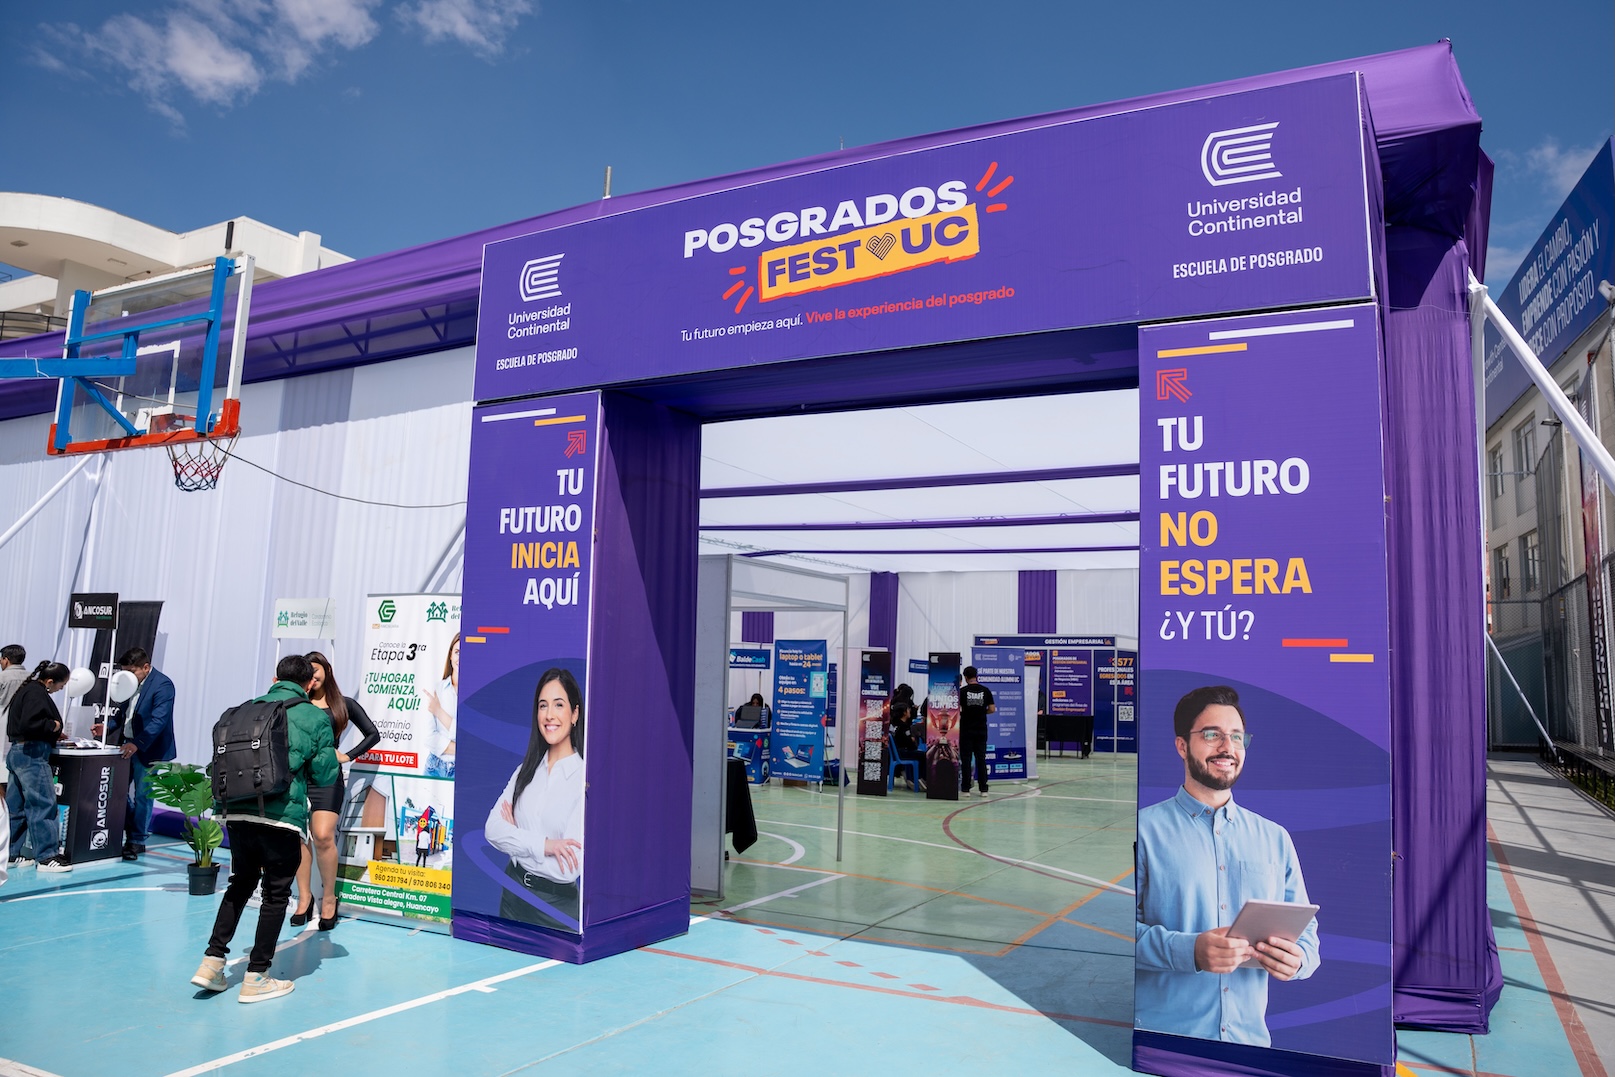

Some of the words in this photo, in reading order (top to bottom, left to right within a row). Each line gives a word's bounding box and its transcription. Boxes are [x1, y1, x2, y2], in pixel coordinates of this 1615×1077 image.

[1187, 187, 1302, 217] Universidad
[684, 180, 968, 258] POSGRADOS
[1188, 207, 1303, 237] Continental
[767, 239, 861, 288] FEST
[901, 216, 970, 255] UC
[1173, 258, 1228, 279] ESCUELA
[1230, 256, 1246, 272] DE
[1249, 246, 1323, 270] POSGRADO
[1538, 252, 1546, 280] EL
[1544, 217, 1573, 271] CAMBIO,
[1521, 278, 1554, 337] EMPRENDE
[1552, 260, 1568, 299] CON
[1566, 226, 1594, 282] PASIÓN
[1592, 218, 1600, 249] Y
[508, 302, 572, 325] Universidad
[681, 329, 693, 342] Tu
[694, 324, 726, 340] futuro
[728, 318, 774, 337] empieza
[776, 313, 804, 331] aquí.
[806, 309, 833, 325] Vive
[834, 308, 846, 321] la
[848, 297, 924, 320] experiencia
[926, 294, 947, 308] del
[949, 286, 1016, 308] posgrado
[1543, 311, 1558, 348] CON
[1556, 270, 1595, 334] PROPÓSITO
[508, 318, 570, 339] Continental
[496, 355, 526, 371] ESCUELA
[528, 353, 537, 366] DE
[538, 347, 578, 365] POSGRADO
[1157, 415, 1204, 452] TU
[556, 468, 584, 496] TU
[1159, 457, 1310, 499] FUTURO
[500, 504, 582, 534] FUTURO
[1160, 510, 1218, 547] NO
[511, 541, 580, 569] INICIA
[1160, 557, 1313, 596] ESPERA
[523, 572, 580, 610] AQUÍ
[84, 606, 112, 616] ANCOSUR
[1159, 610, 1195, 641] ¿Y
[1201, 604, 1255, 641] TÚ?
[371, 648, 404, 664] Etapa
[779, 653, 798, 661] laptop
[367, 684, 415, 696] COMIENZA
[381, 672, 415, 684] HOGAR
[784, 687, 806, 695] pasos:
[388, 694, 421, 710] AQUÍ!
[966, 692, 984, 700] STAFF
[384, 754, 395, 762] TU
[396, 755, 414, 764] LOTE
[97, 767, 110, 828] ANCOSUR
[376, 864, 400, 874] Agenda
[352, 885, 380, 896] Carretera
[382, 889, 404, 899] Central
[406, 892, 418, 902] Km.
[413, 878, 424, 886] 970
[438, 882, 450, 890] 340
[339, 892, 366, 902] Paradero
[367, 896, 383, 904] Vista
[406, 902, 439, 914] Huancayo
